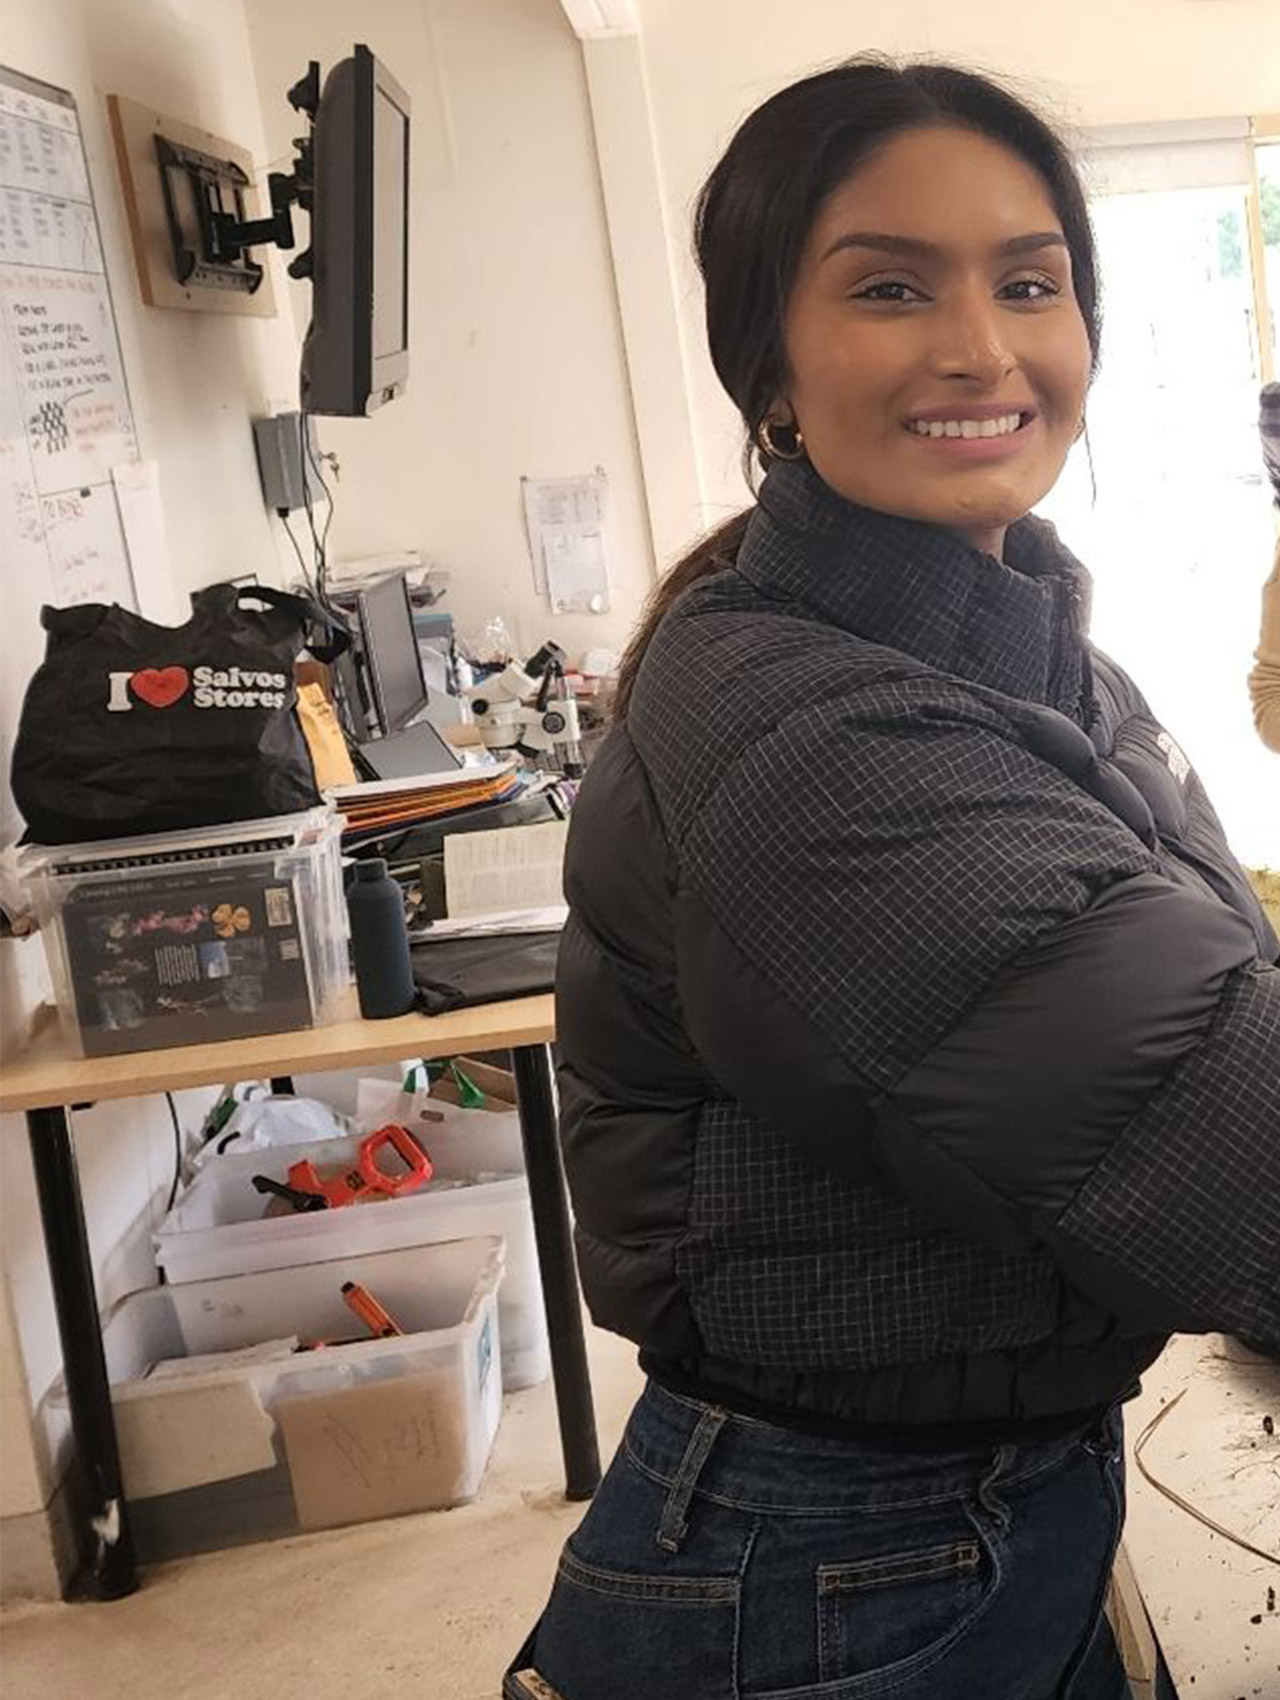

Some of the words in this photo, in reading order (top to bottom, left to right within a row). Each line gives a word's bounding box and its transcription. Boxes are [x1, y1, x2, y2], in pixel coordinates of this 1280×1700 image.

[193, 666, 286, 688] Salvos
[107, 672, 134, 711] I
[194, 688, 285, 709] Stores
